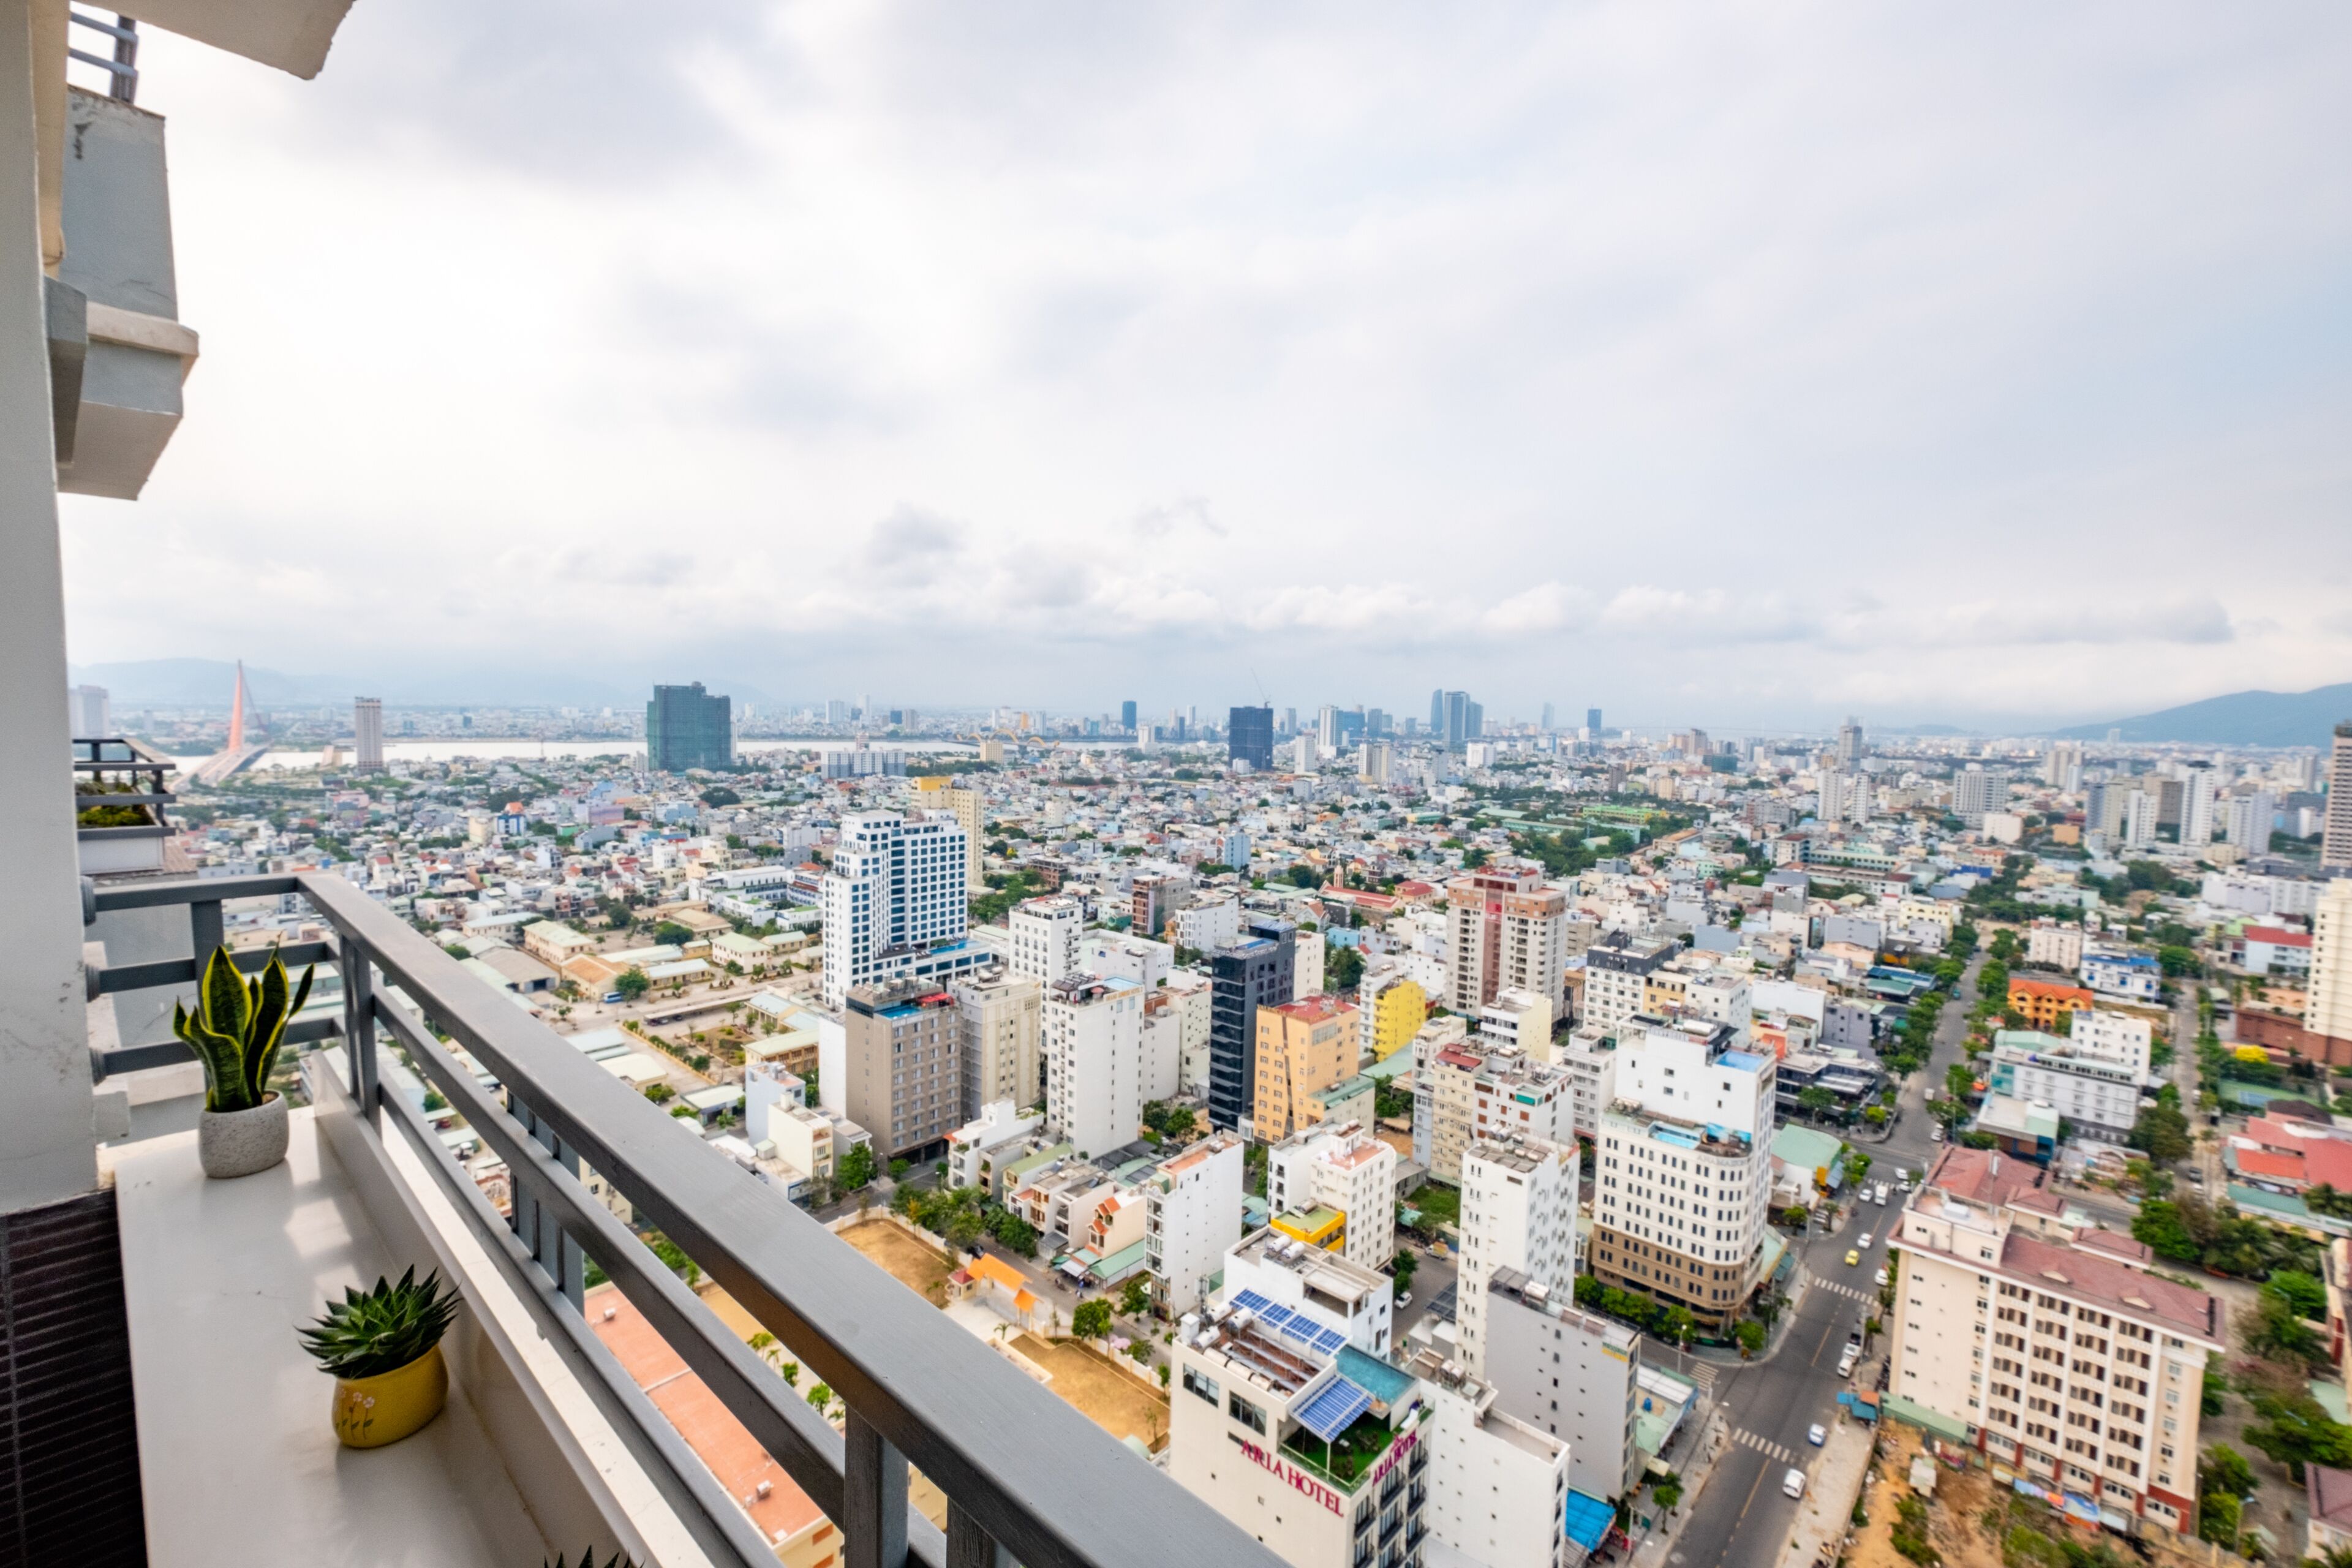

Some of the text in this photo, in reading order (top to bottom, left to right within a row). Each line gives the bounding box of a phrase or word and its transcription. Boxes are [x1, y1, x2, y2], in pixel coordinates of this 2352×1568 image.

[1240, 1439, 1344, 1518] ARIA HOTEL
[1372, 1429, 1417, 1488] ARIA HOTEL
